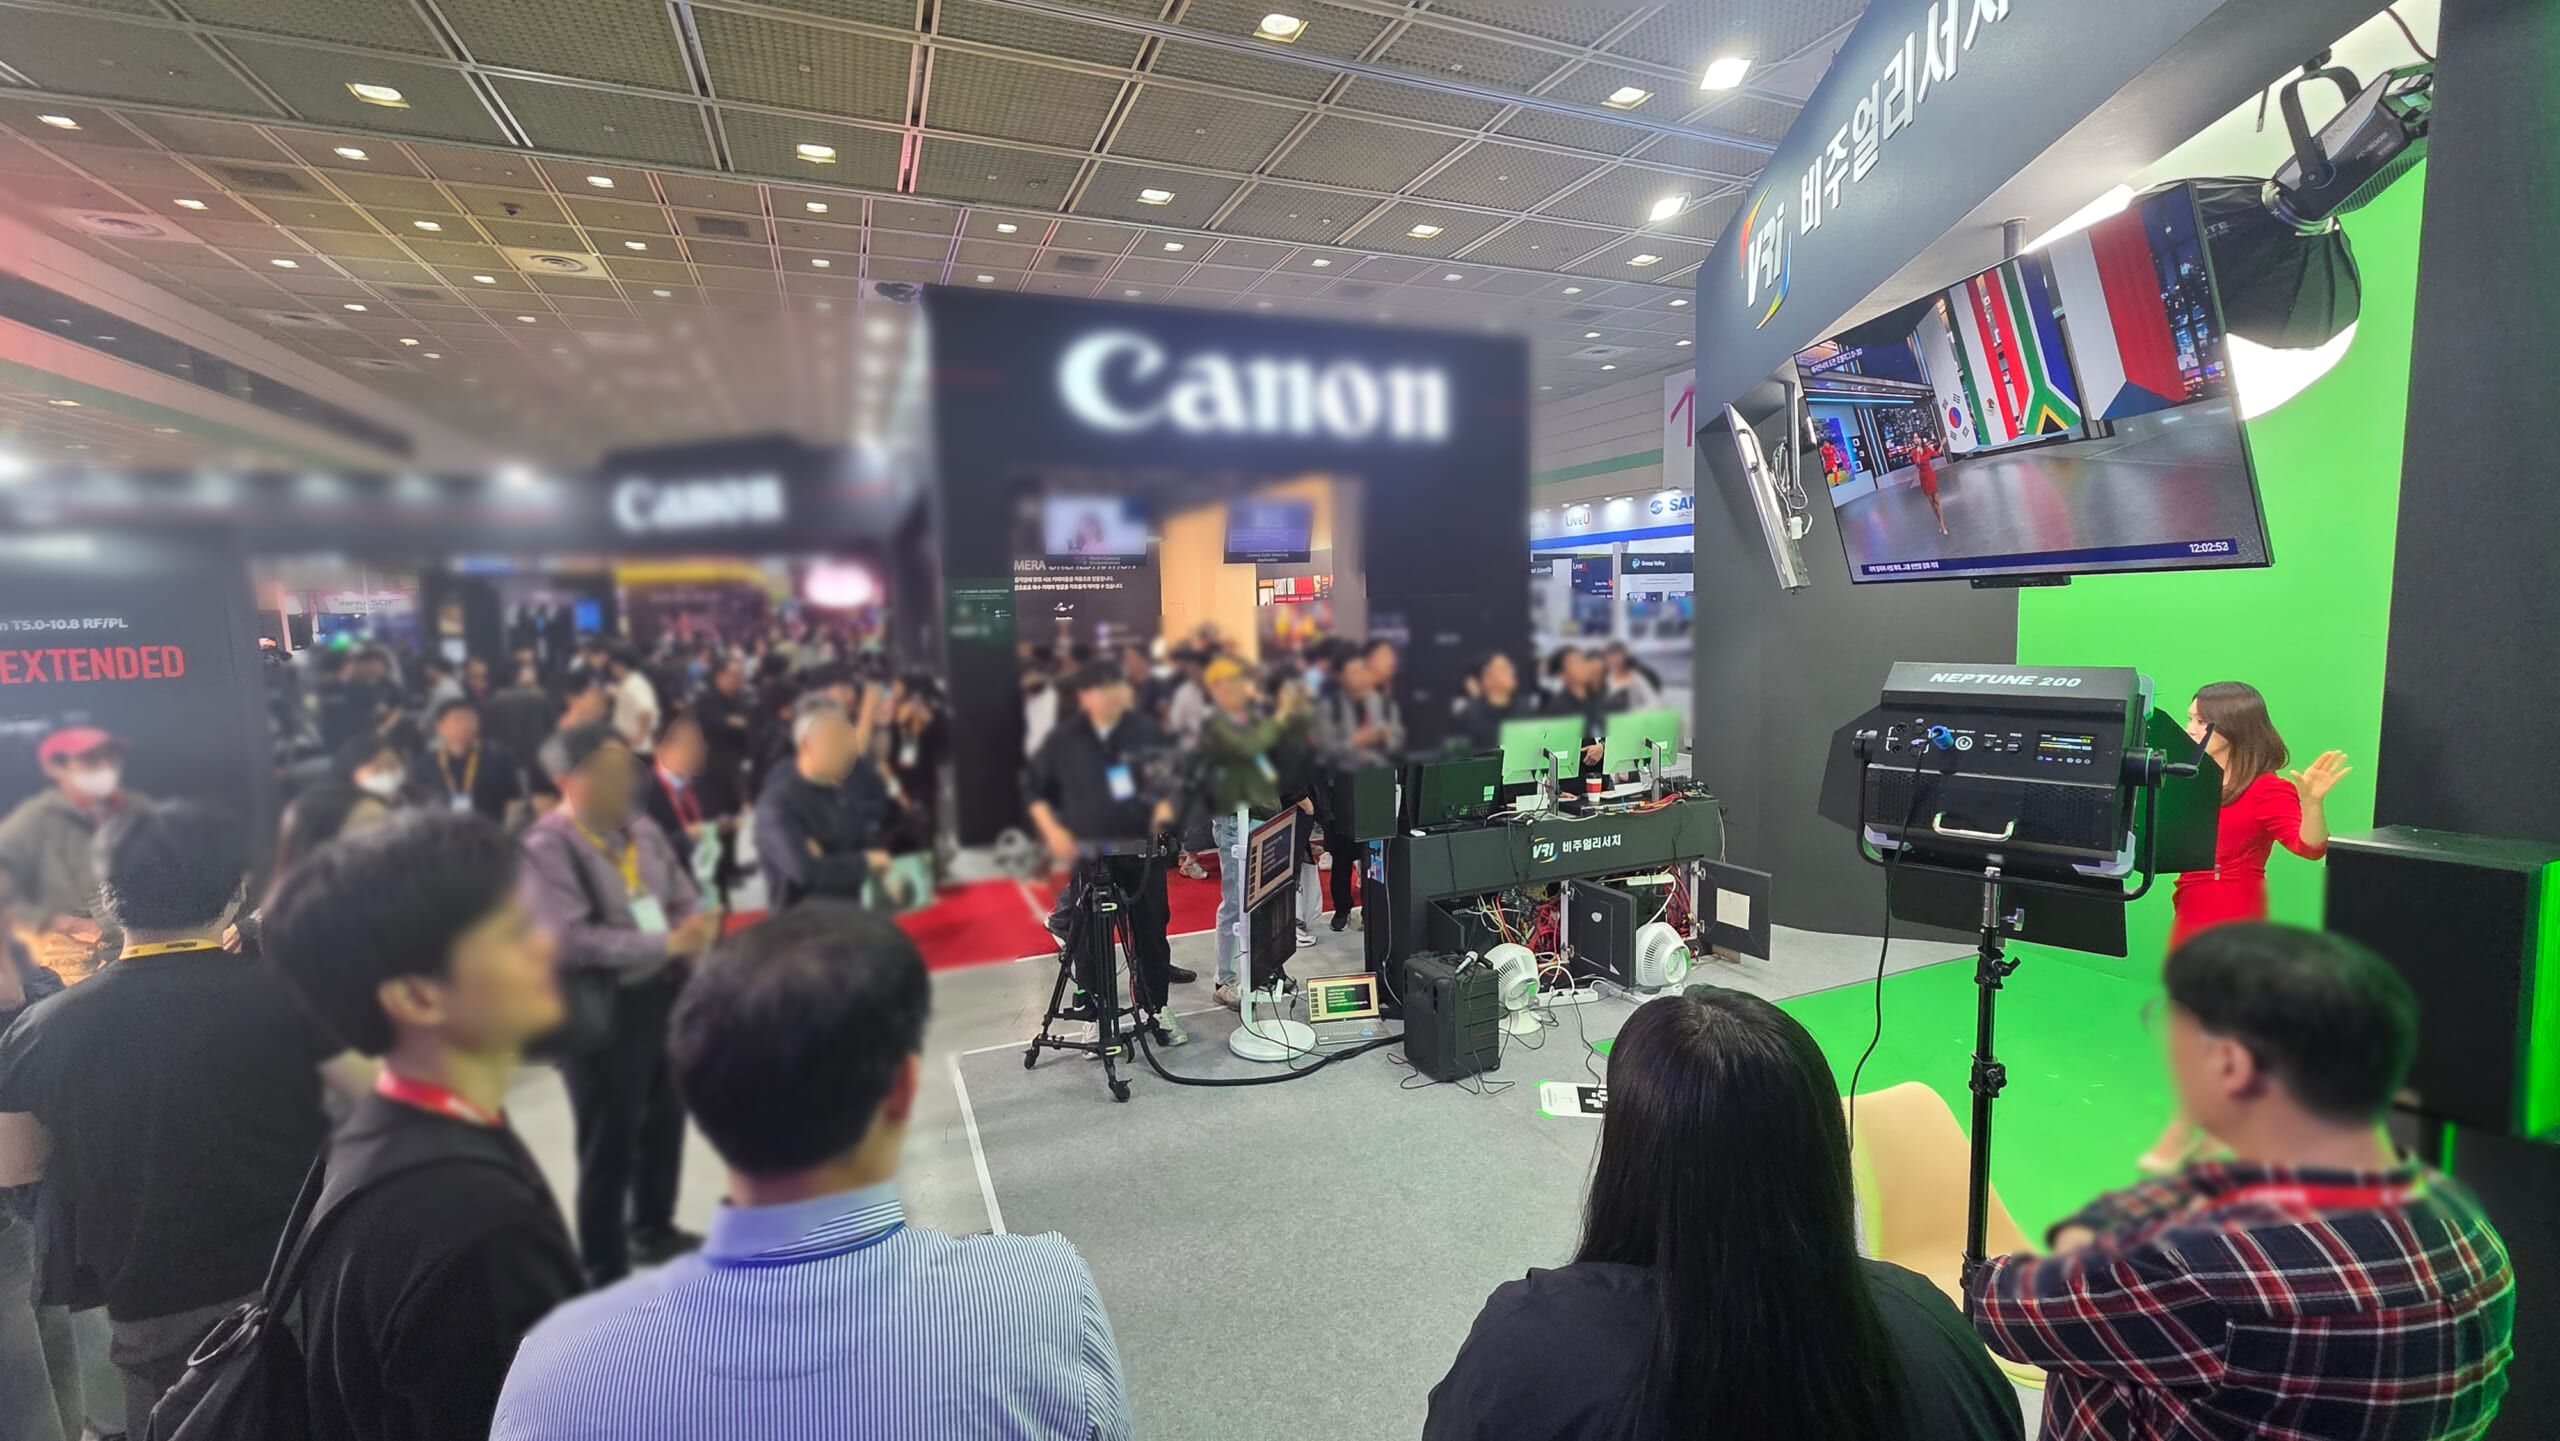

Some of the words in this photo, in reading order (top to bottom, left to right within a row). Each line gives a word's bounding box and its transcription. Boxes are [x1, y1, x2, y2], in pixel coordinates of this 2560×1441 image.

[1059, 330, 1449, 438] Canon
[2189, 541, 2230, 553] 12:02:53
[10, 618, 80, 631] T5.0-10.8
[82, 617, 129, 629] RF/PL
[0, 645, 185, 685] EXTENDED
[1929, 673, 2038, 686] NEPTUNE
[2038, 677, 2082, 688] 200
[1562, 834, 1622, 853] 비주얼리서치
